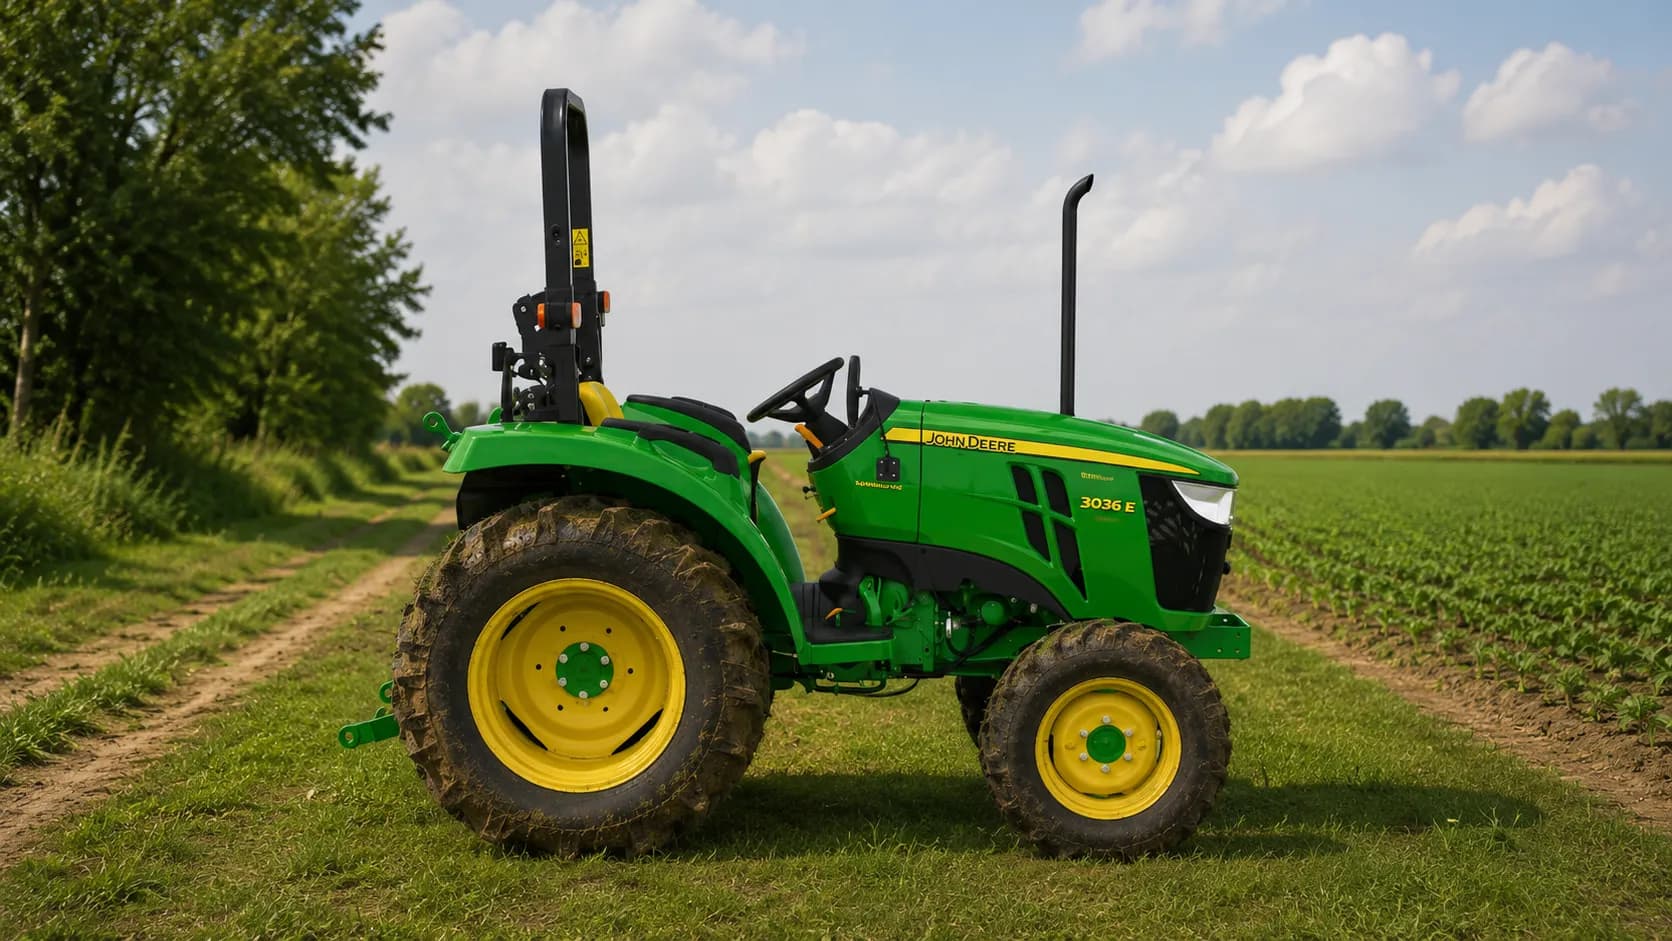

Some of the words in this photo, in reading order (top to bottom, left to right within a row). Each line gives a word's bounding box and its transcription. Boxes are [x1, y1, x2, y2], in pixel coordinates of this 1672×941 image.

[926, 432, 965, 447] JOHN
[968, 435, 1016, 452] DEERE
[1080, 496, 1122, 511] 3036
[1125, 501, 1136, 513] E
